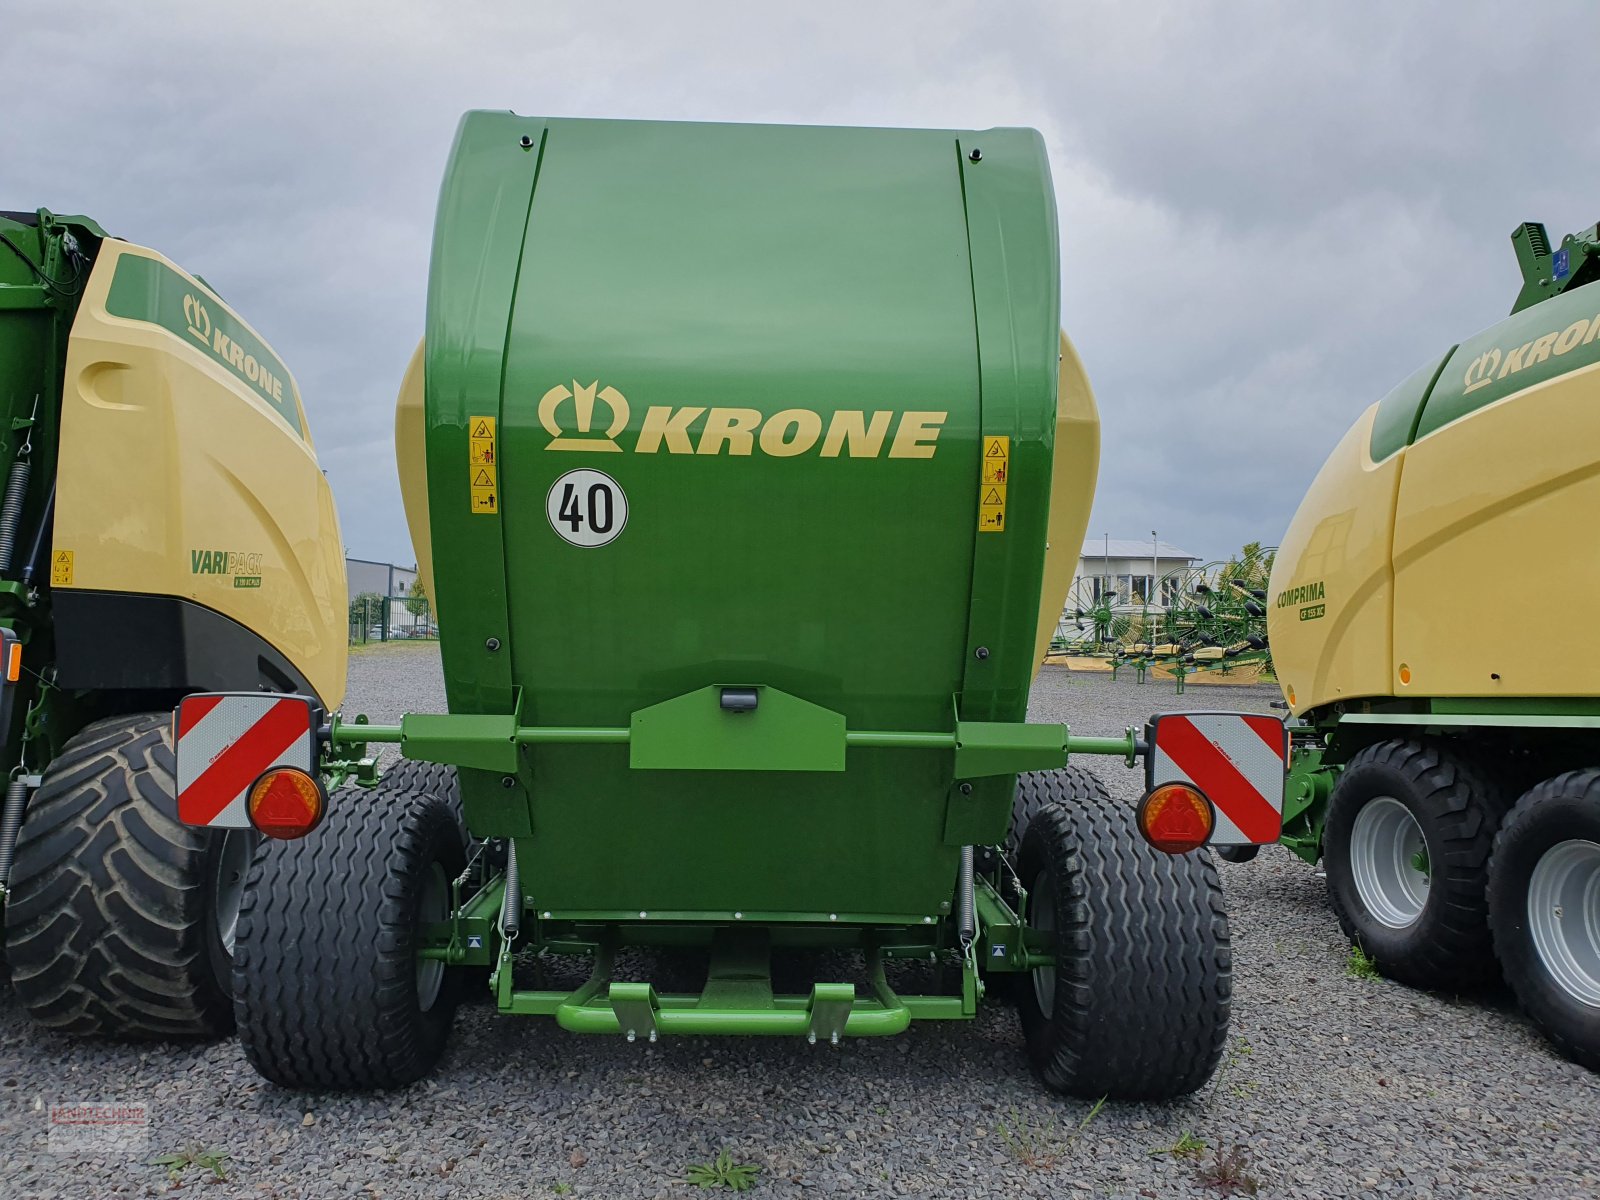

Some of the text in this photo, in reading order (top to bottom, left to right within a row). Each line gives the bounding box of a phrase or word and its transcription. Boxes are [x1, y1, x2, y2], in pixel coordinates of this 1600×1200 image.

[213, 327, 282, 404] KRONE
[634, 405, 948, 459] KRONE
[558, 483, 614, 534] 40
[191, 549, 263, 575] VARIPACK
[1277, 581, 1325, 609] COMPRIMA
